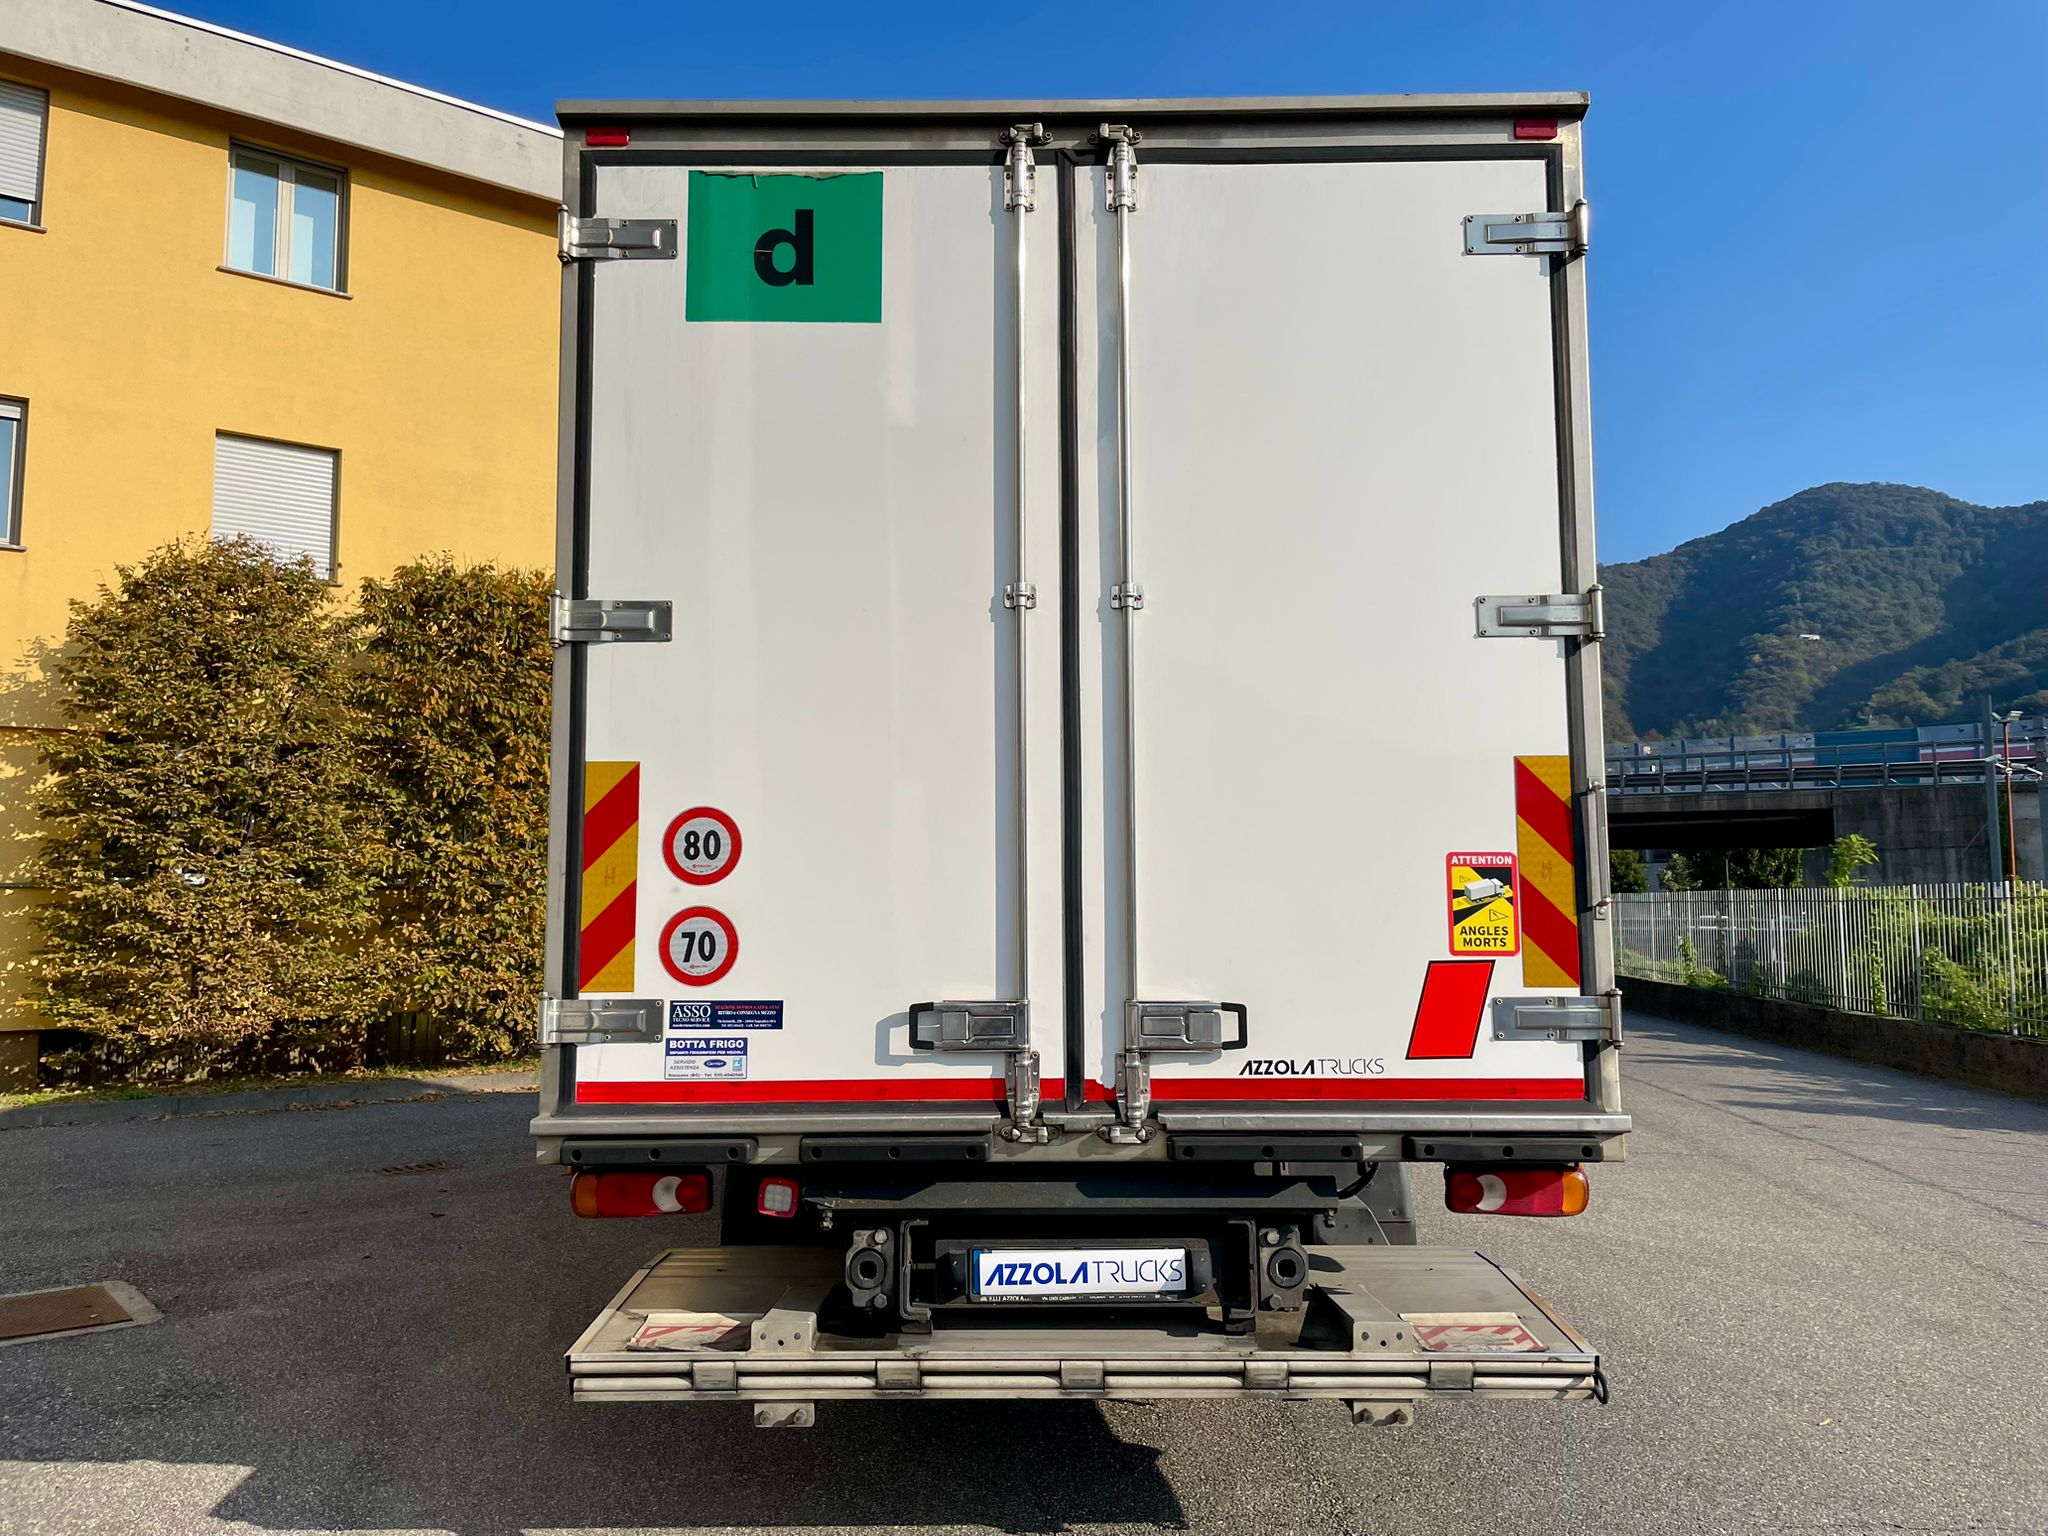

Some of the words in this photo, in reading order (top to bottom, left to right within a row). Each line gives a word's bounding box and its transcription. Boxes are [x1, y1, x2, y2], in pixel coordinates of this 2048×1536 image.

[754, 209, 814, 287] d
[683, 829, 722, 861] 80
[1451, 856, 1512, 865] ATTENTION
[1460, 926, 1509, 936] ANGLES
[681, 930, 716, 963] 70
[1463, 937, 1507, 947] MORTS
[672, 1004, 711, 1018] ASSO
[669, 1040, 706, 1049] BOTTA
[709, 1040, 744, 1048] FRIGO
